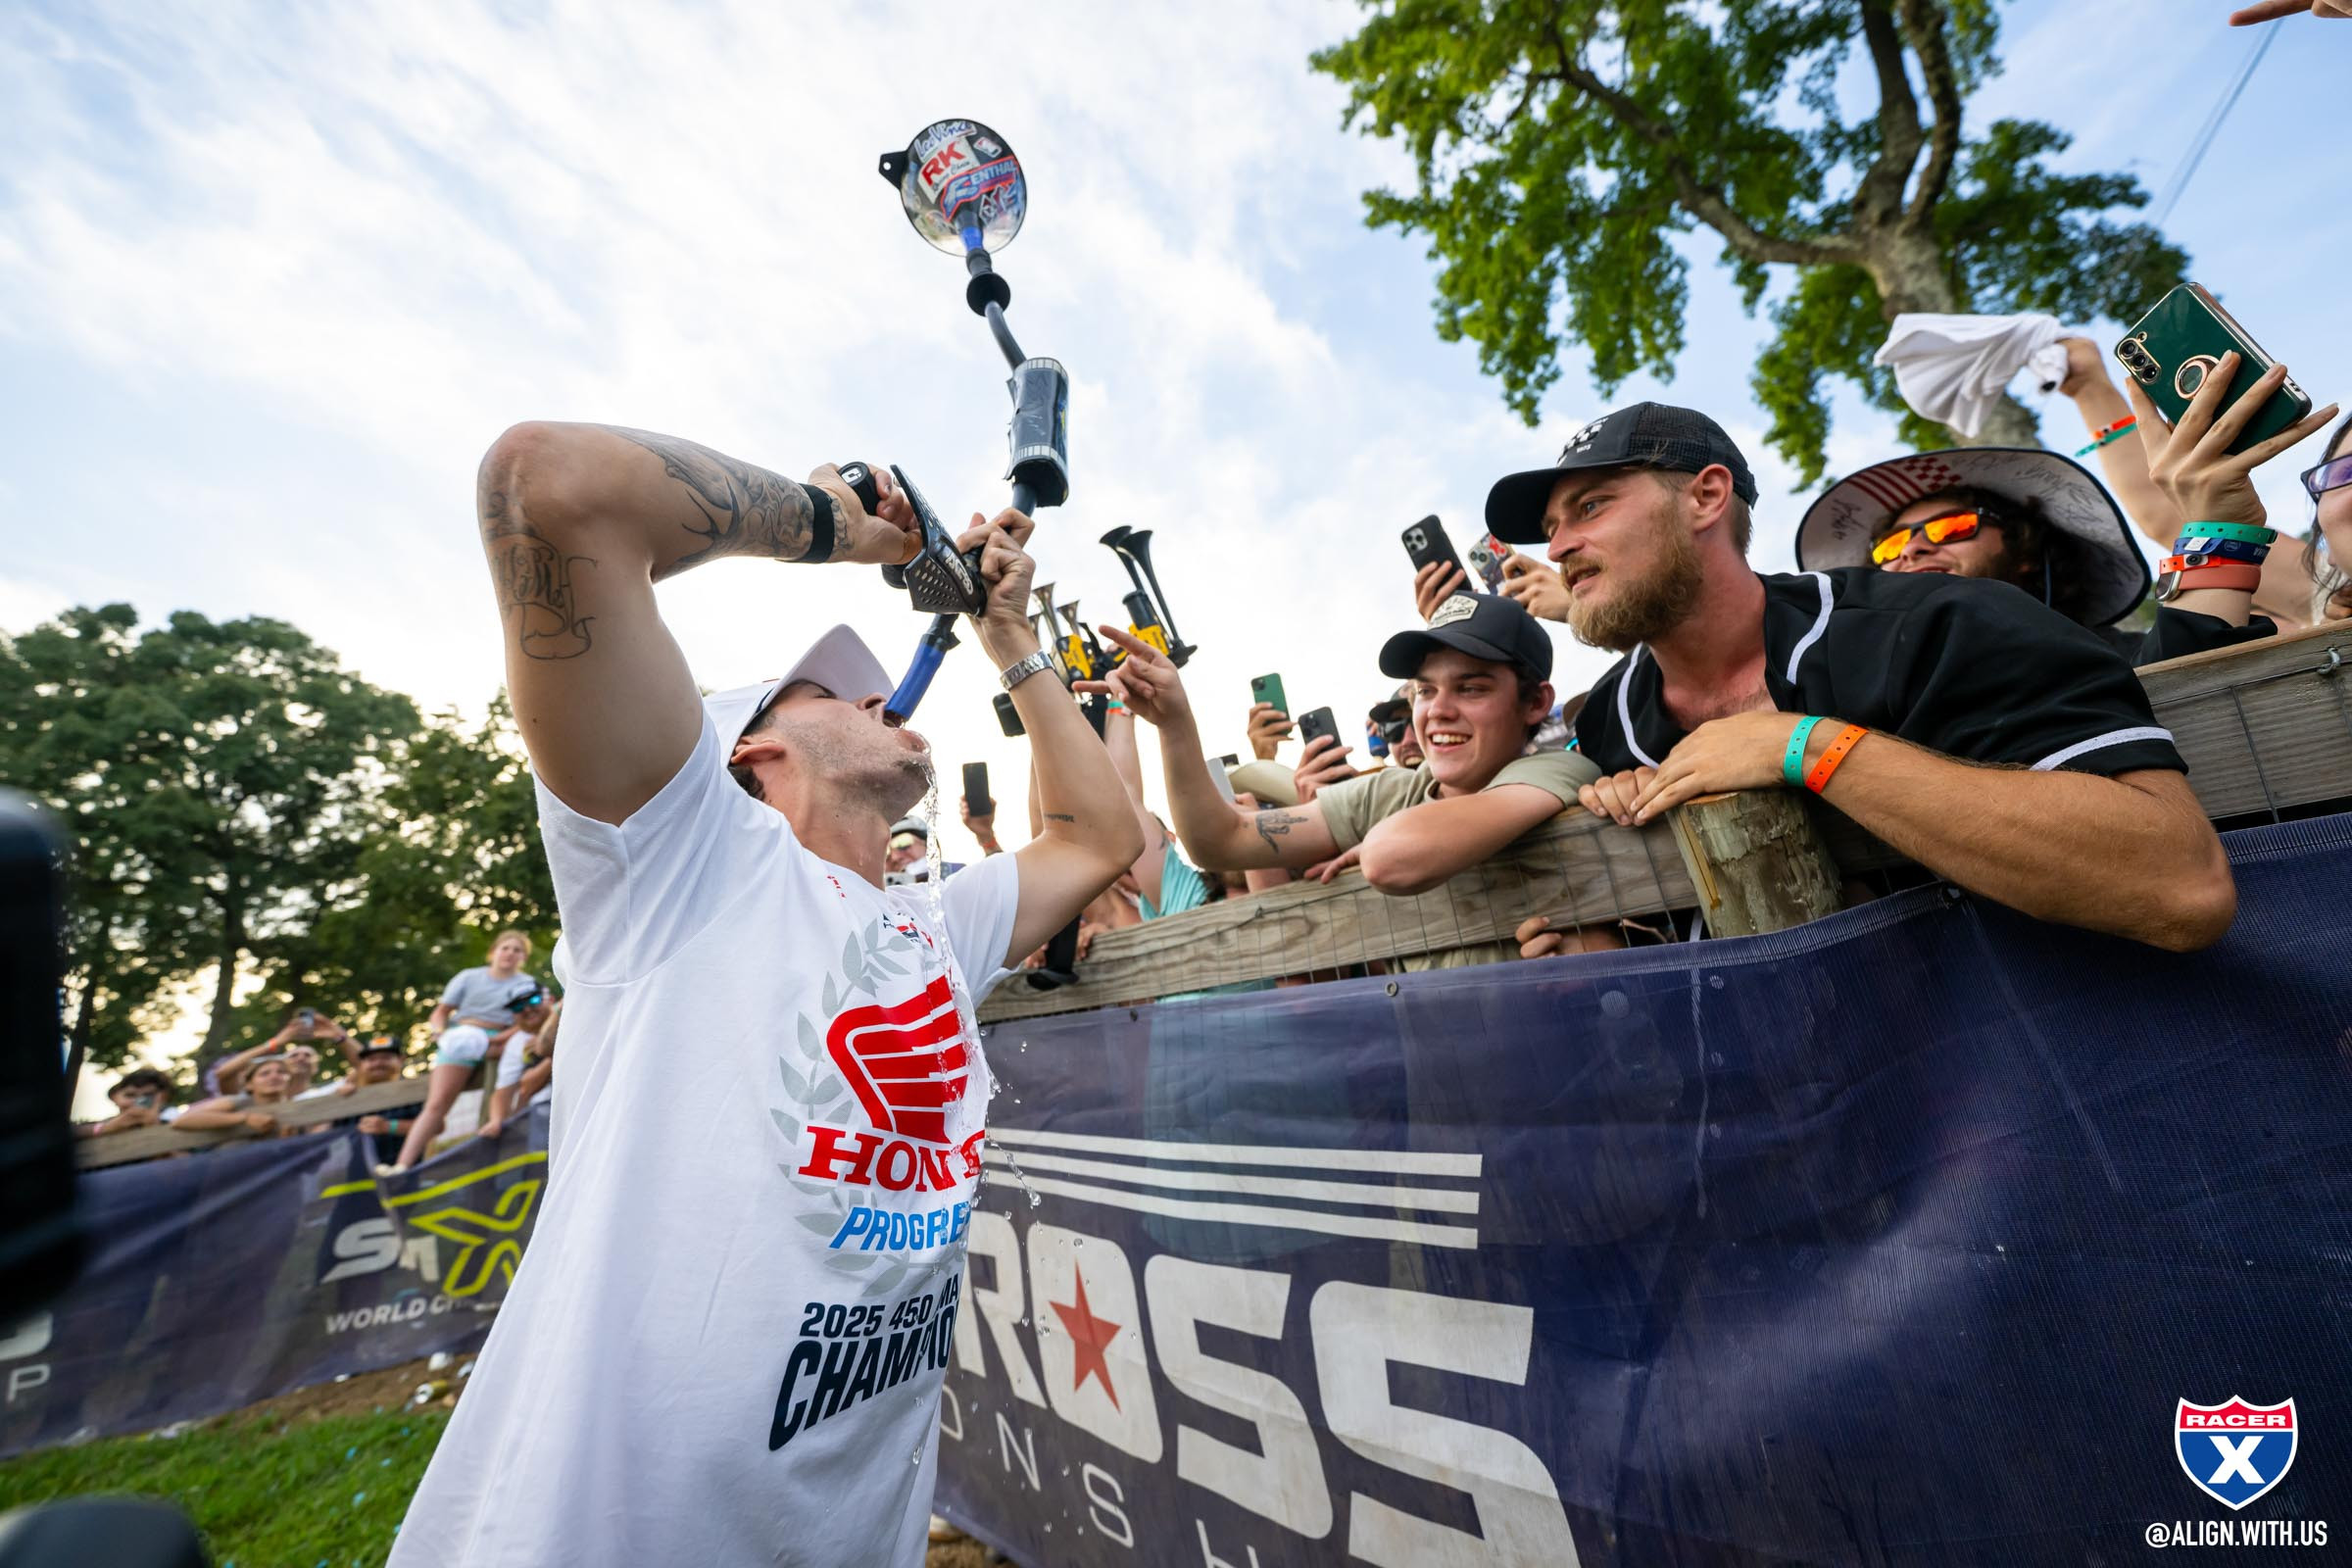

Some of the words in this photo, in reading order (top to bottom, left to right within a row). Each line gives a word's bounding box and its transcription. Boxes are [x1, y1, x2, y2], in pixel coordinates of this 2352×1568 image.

[921, 141, 965, 185] RK
[325, 1297, 427, 1335] WORLD
[800, 1301, 886, 1339] 2025
[888, 1294, 934, 1329] 450
